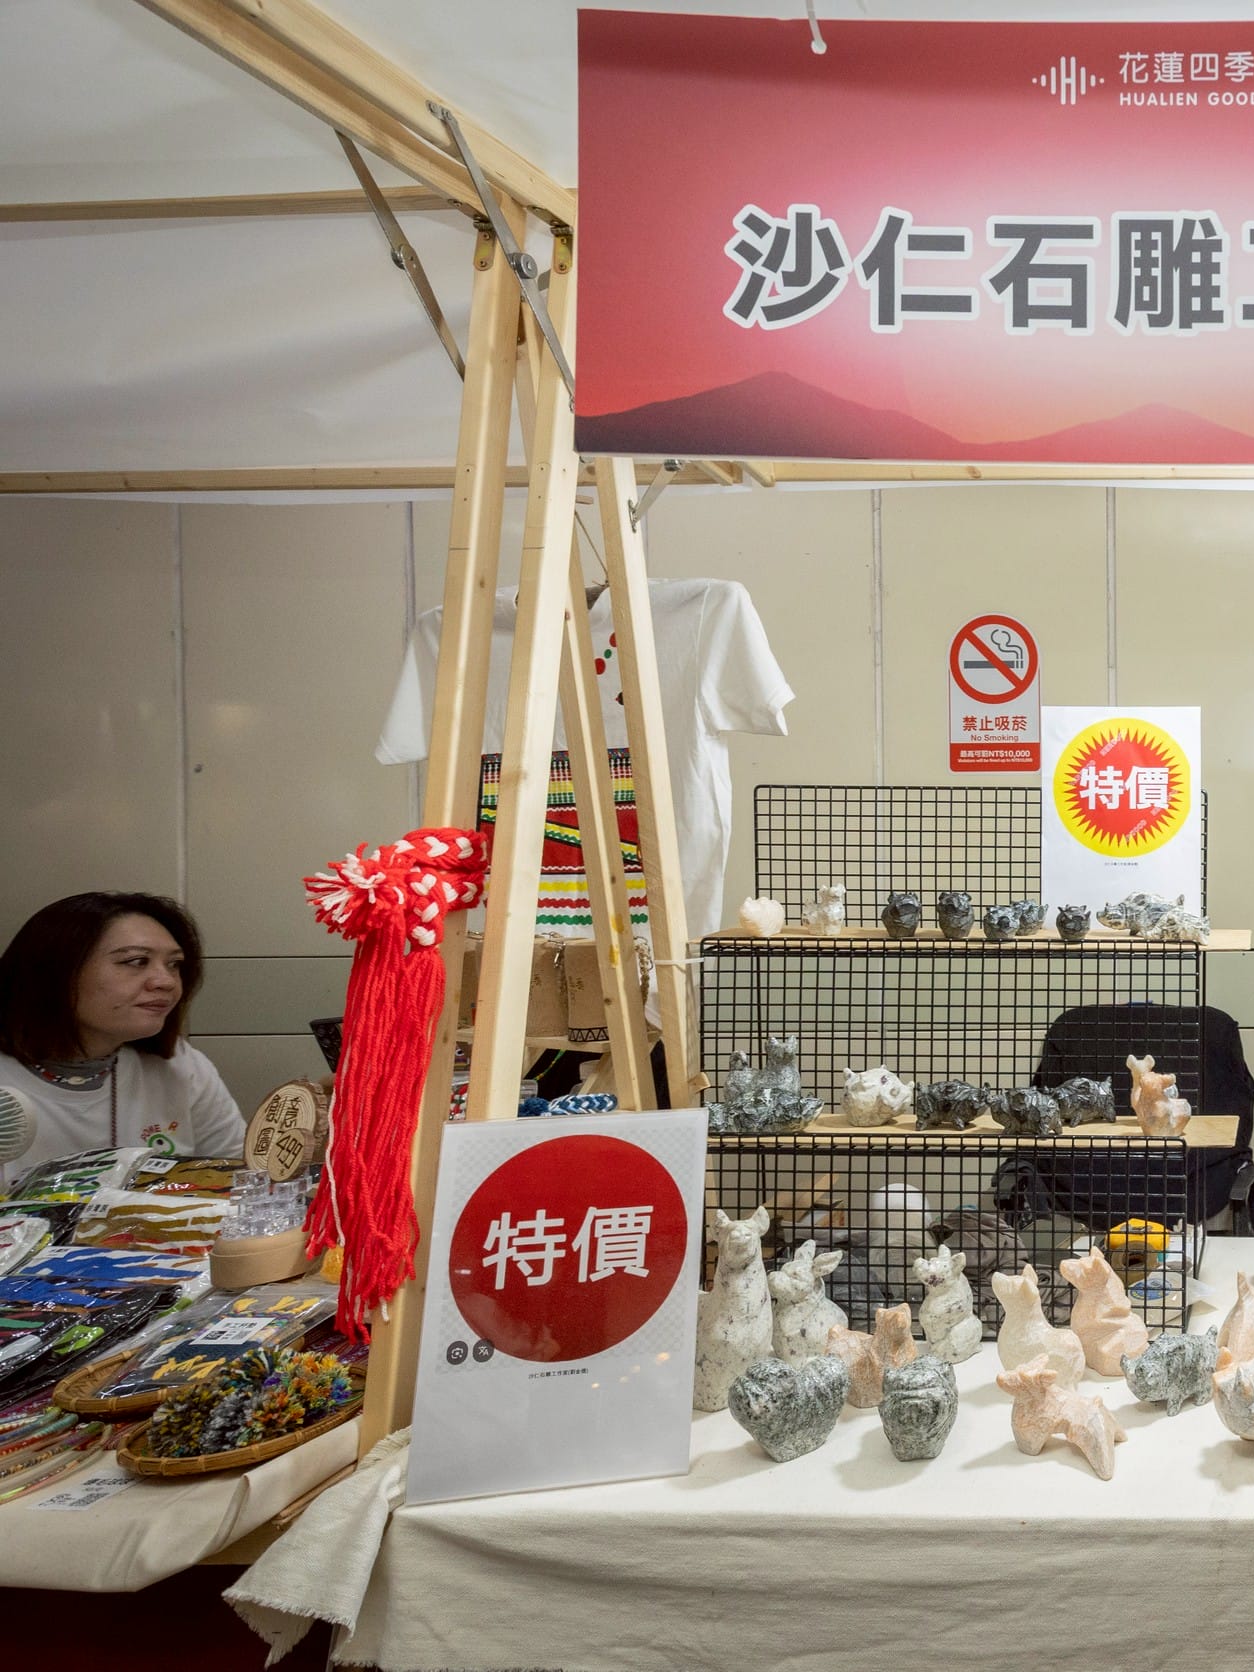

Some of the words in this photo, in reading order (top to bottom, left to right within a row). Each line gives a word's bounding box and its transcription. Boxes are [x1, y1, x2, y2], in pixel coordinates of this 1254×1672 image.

[1119, 92, 1198, 106] HUALIEN
[962, 715, 1028, 731] 禁止吸菸
[983, 734, 1019, 742] Smoking
[1079, 765, 1170, 810] 特價
[276, 1135, 303, 1169] 499
[482, 1205, 654, 1290] 特價
